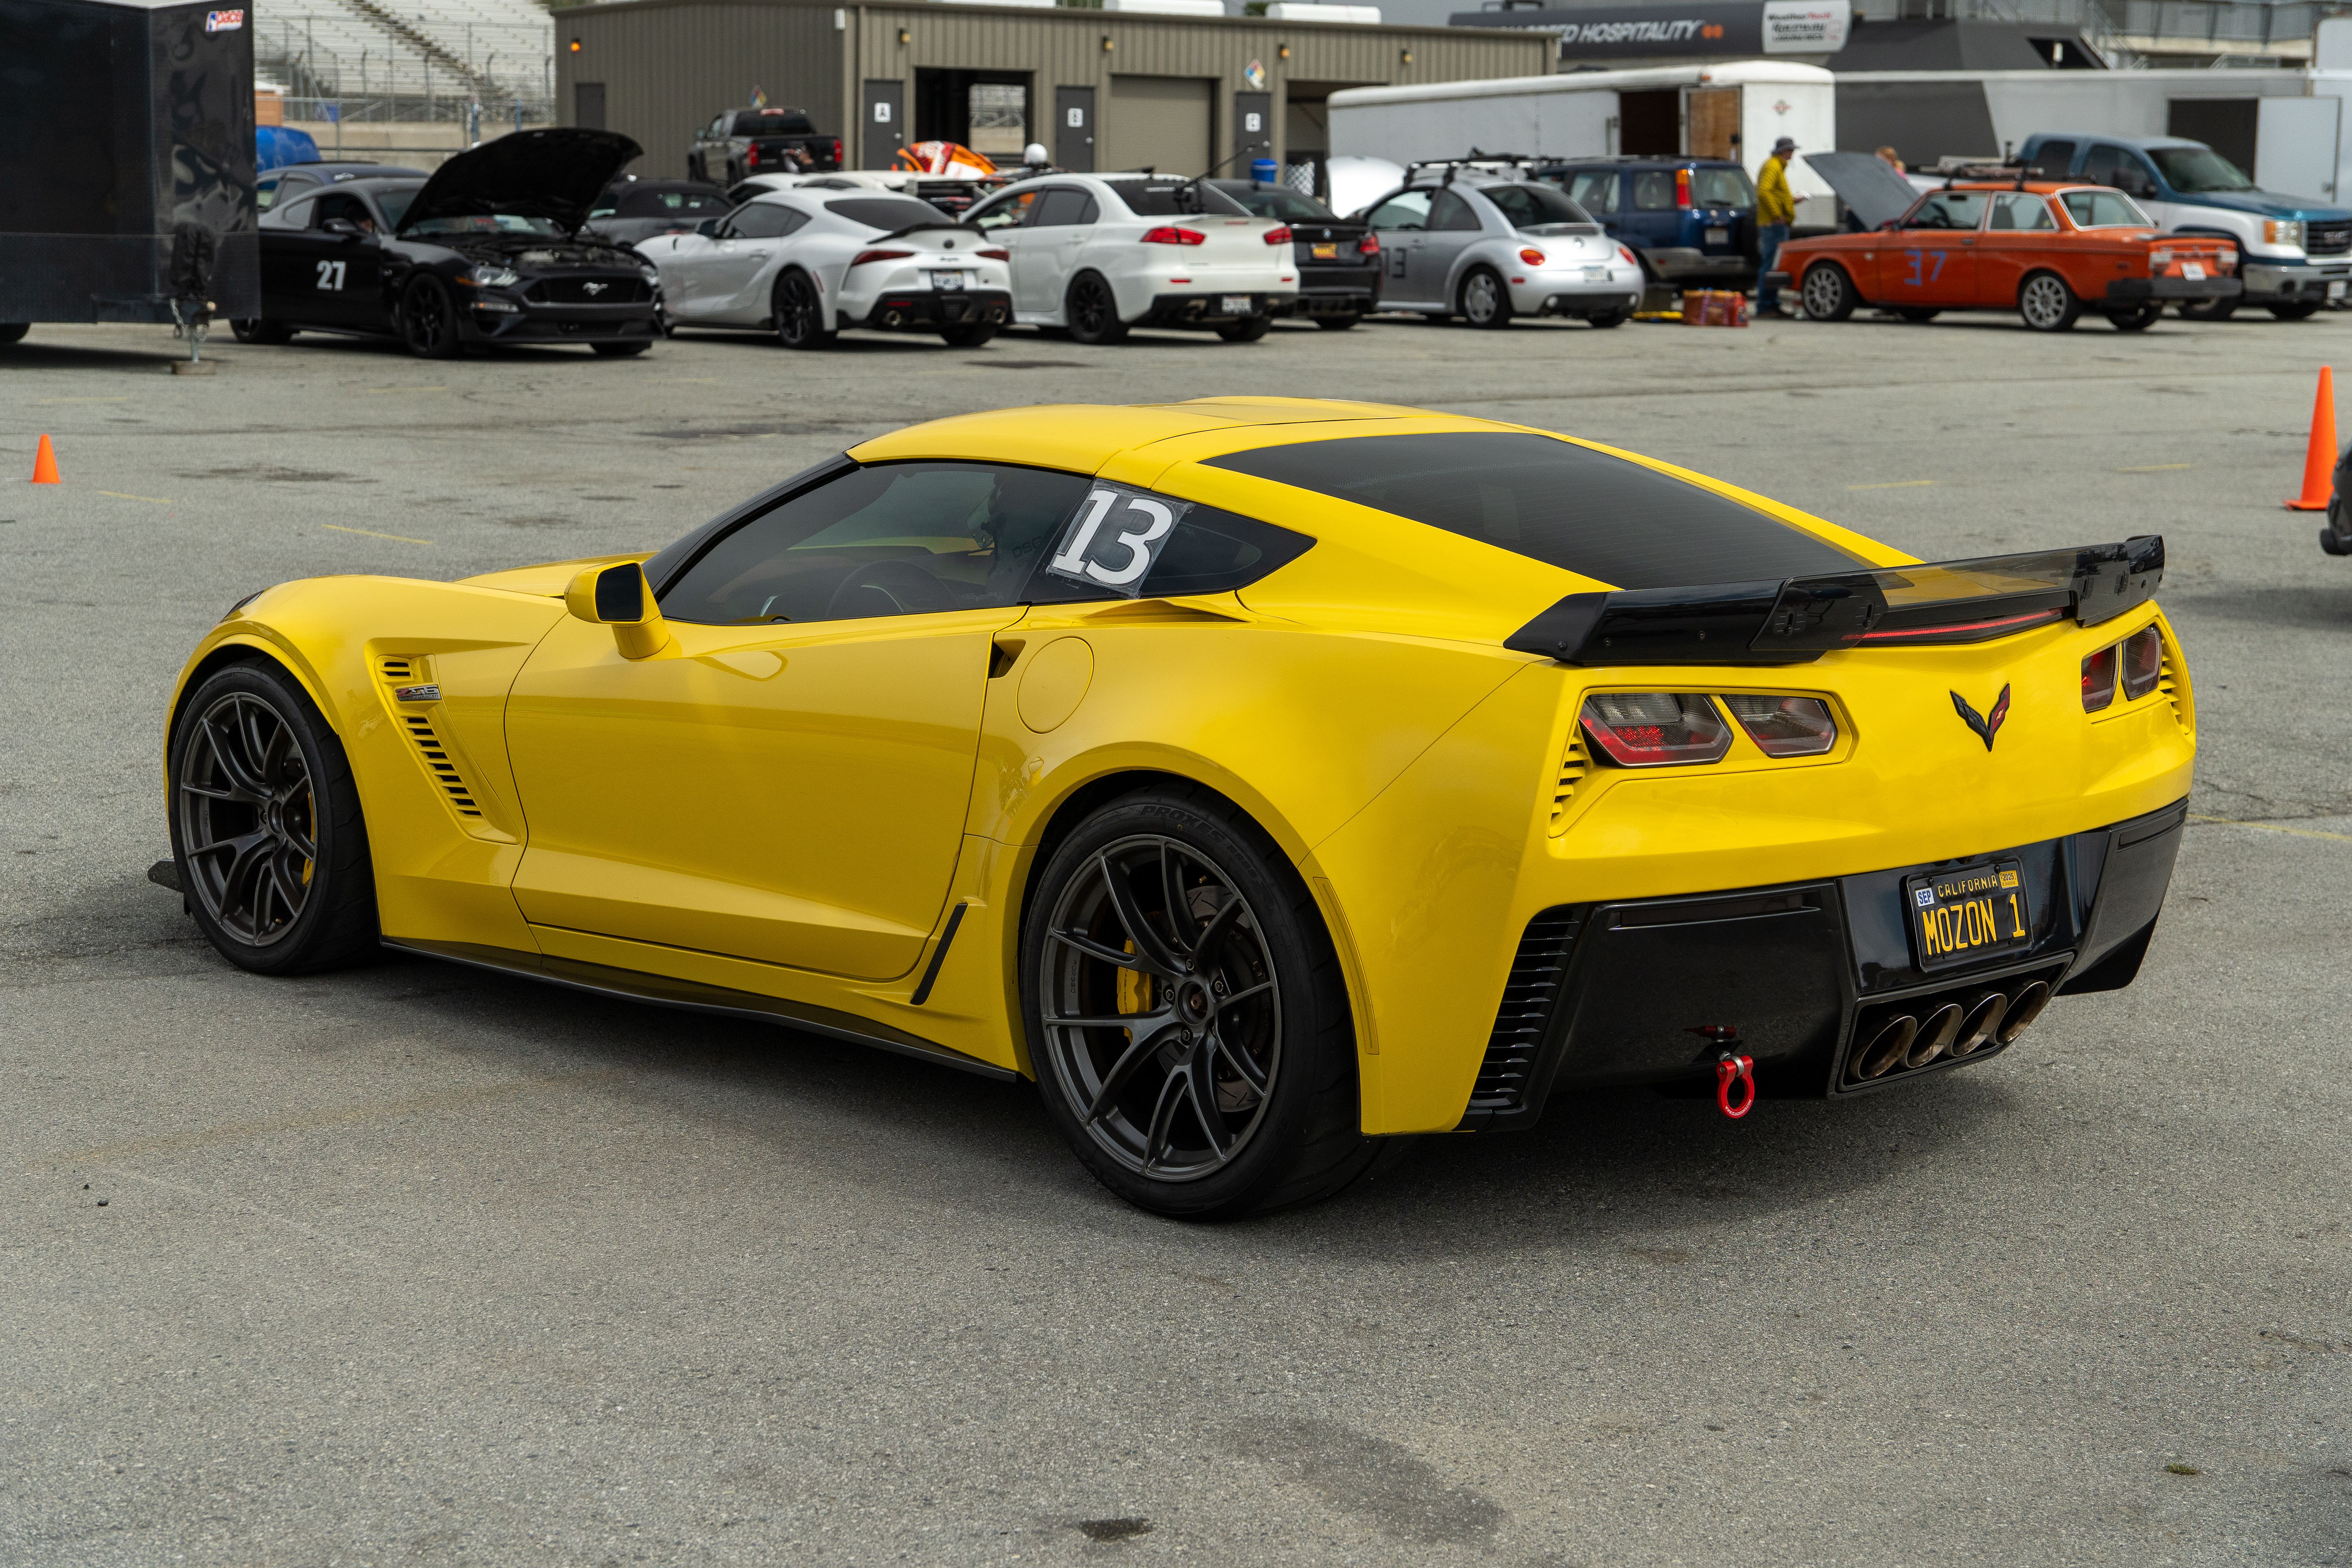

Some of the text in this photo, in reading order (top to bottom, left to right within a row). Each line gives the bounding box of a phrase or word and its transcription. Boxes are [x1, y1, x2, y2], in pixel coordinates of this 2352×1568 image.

[1579, 20, 1704, 43] HOSPITALITY
[317, 260, 346, 291] 27
[1904, 250, 1946, 286] 37
[1052, 490, 1172, 584] 13
[1140, 805, 1226, 844] PROXES
[1938, 875, 1998, 897] CALIFORNIA
[2003, 873, 2014, 881] 2025
[1918, 890, 1931, 905] SEP
[1922, 894, 2025, 955] MOZON 1
